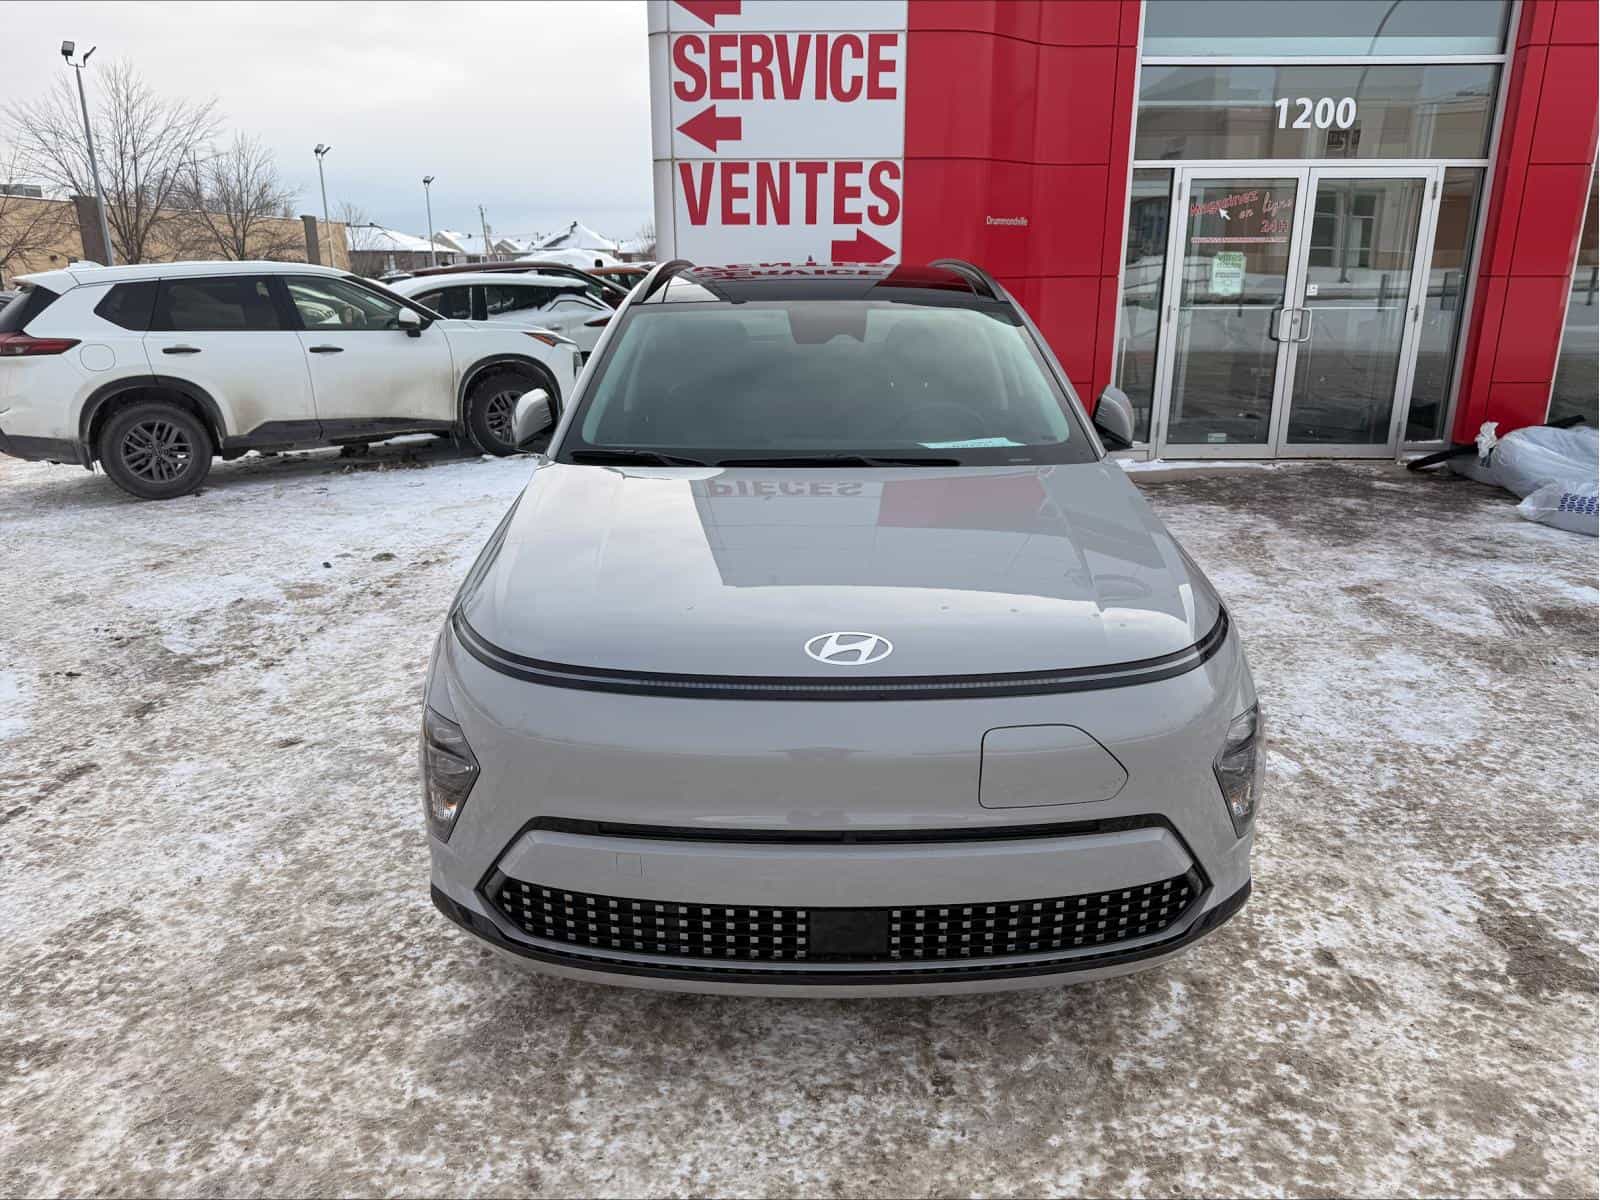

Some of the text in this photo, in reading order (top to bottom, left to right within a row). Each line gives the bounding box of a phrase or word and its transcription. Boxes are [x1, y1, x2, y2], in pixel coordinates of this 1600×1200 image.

[672, 33, 899, 102] SERVICE
[1275, 96, 1358, 129] 1200
[678, 160, 902, 226] VENTES
